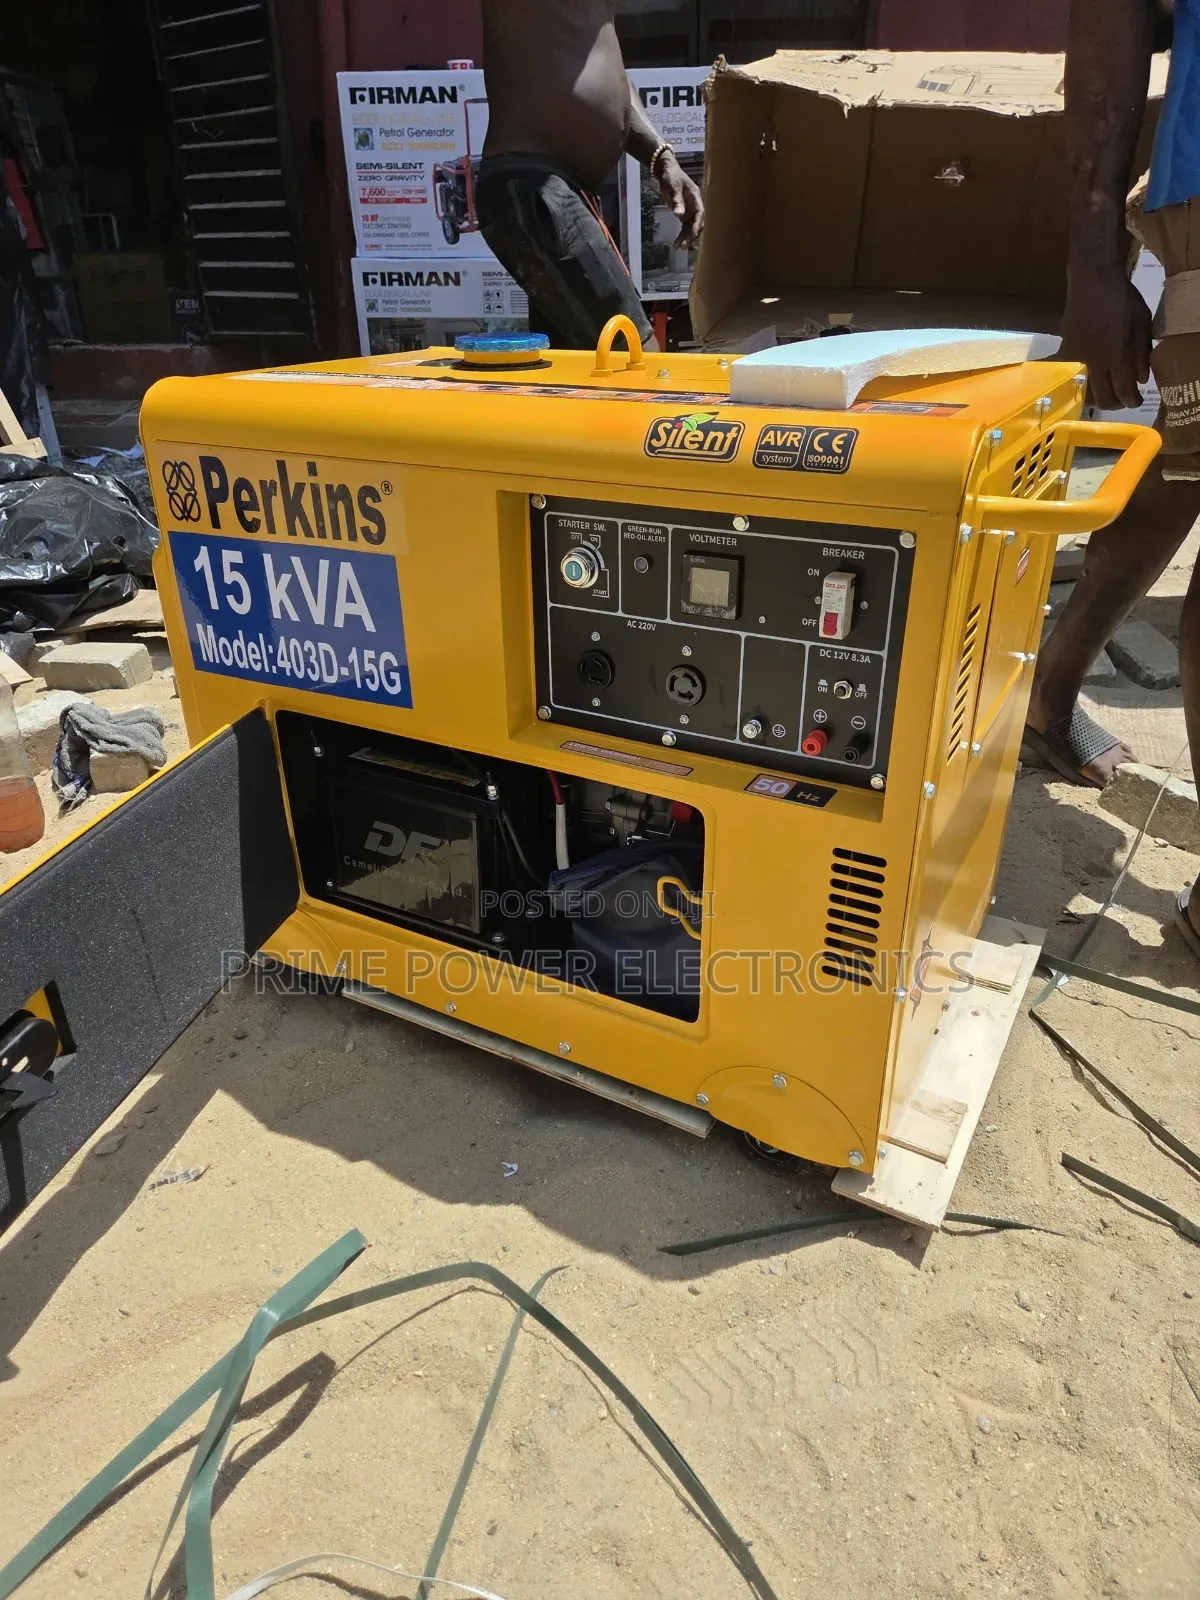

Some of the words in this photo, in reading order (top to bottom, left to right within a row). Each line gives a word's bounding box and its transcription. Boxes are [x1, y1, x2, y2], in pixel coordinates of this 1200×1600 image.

[379, 128, 404, 138] Petrol
[407, 127, 455, 138] Generator
[662, 125, 685, 135] Petrol
[355, 162, 425, 171] SEMI-SILENT
[357, 174, 382, 182] ZERO
[384, 174, 425, 182] GRAVITY
[360, 187, 387, 198] 7,600
[650, 421, 738, 452] Silent
[761, 430, 802, 447] AVR
[761, 455, 793, 465] system
[807, 454, 845, 465] ISO9001
[558, 519, 590, 531] STARTER
[593, 522, 607, 532] SW.
[627, 525, 662, 535] GREEN-RUN
[623, 532, 647, 541] RED-OIL
[647, 534, 667, 543] ALERT
[689, 533, 738, 547] VOLTMETER
[822, 547, 865, 560] BREAKER
[807, 568, 820, 577] ON
[193, 545, 252, 616] 15
[262, 552, 377, 633] kVA
[592, 588, 608, 596] START
[626, 619, 637, 628] AC
[637, 621, 657, 631] 220V
[801, 617, 817, 627] OFF
[195, 622, 402, 695] Model:403D-15G
[819, 648, 832, 658] DC
[833, 651, 850, 661] 12V
[850, 653, 871, 664] 8.3A
[817, 685, 828, 694] ON
[854, 691, 869, 699] OFF
[753, 777, 790, 794] 50
[796, 791, 821, 802] Hz
[343, 855, 376, 872] Camel
